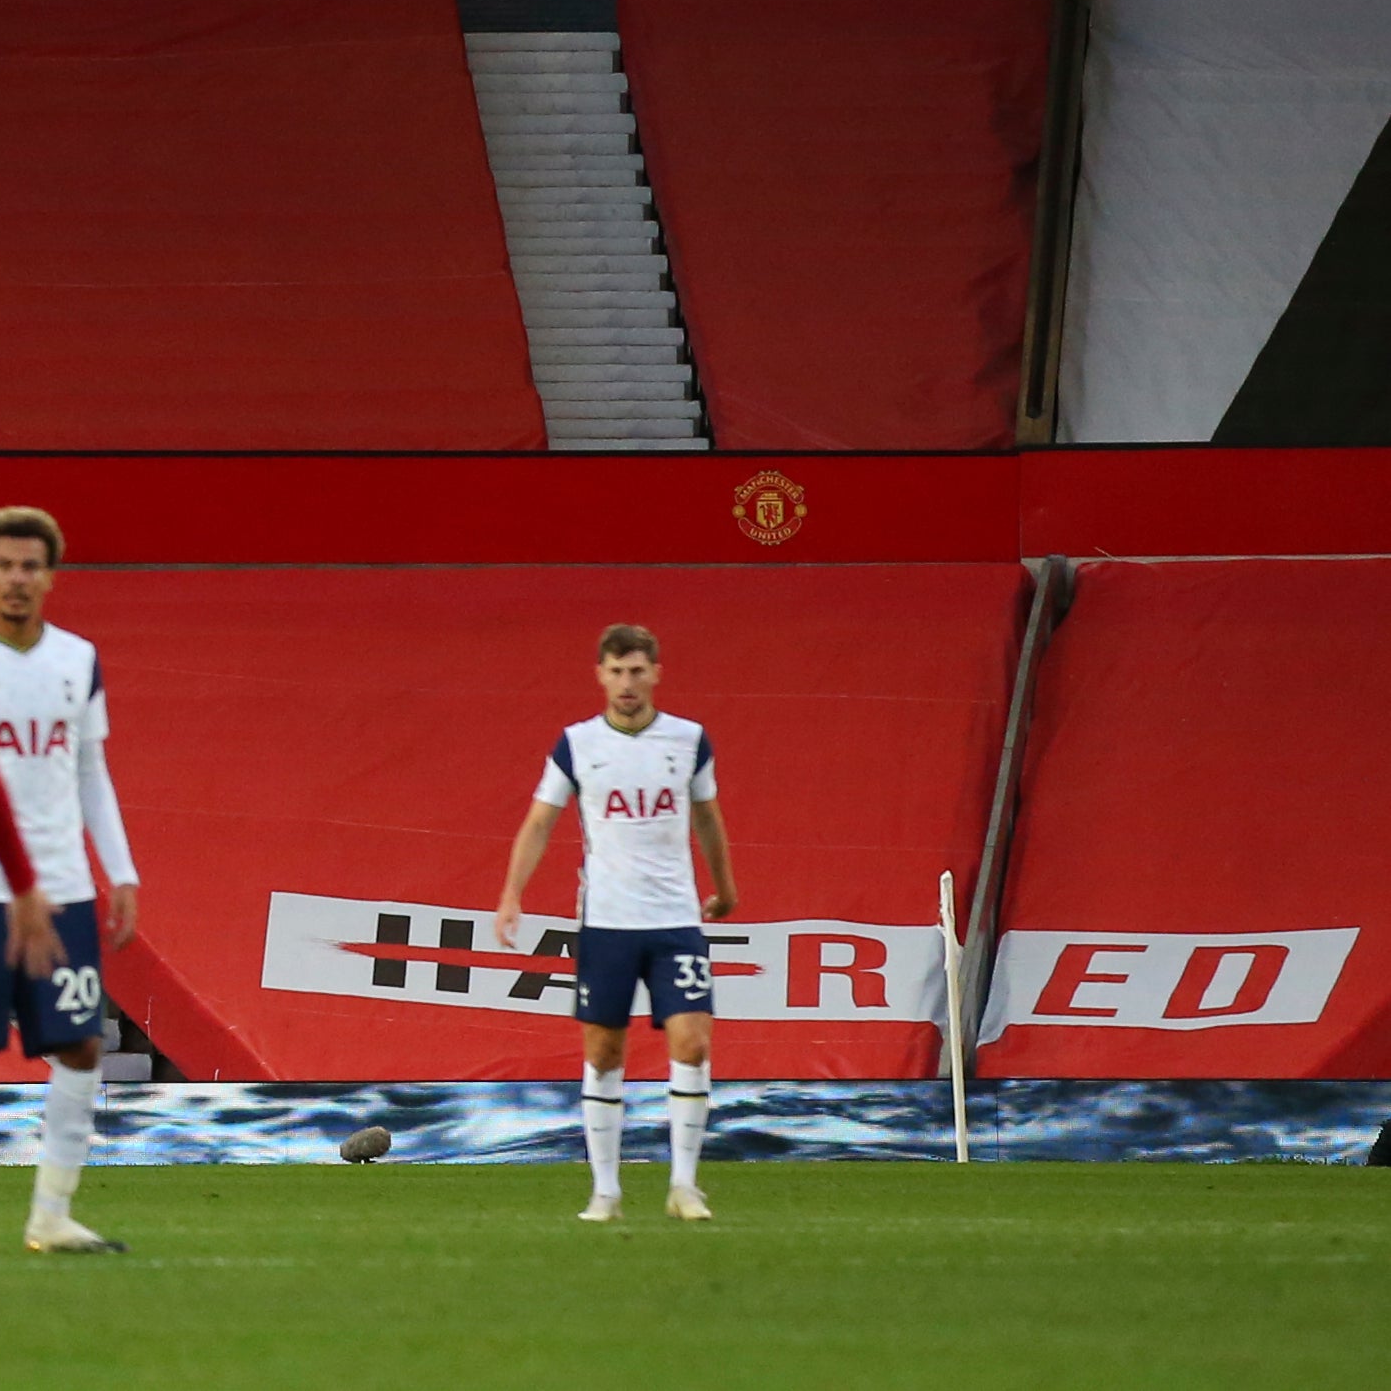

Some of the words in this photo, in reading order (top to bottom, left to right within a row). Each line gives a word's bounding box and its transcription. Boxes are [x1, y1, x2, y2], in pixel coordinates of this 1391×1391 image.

[739, 476, 799, 499] MANCHESTER
[749, 527, 792, 540] UNITED
[605, 788, 678, 819] AIA
[673, 954, 712, 990] 33
[51, 965, 101, 1012] 20
